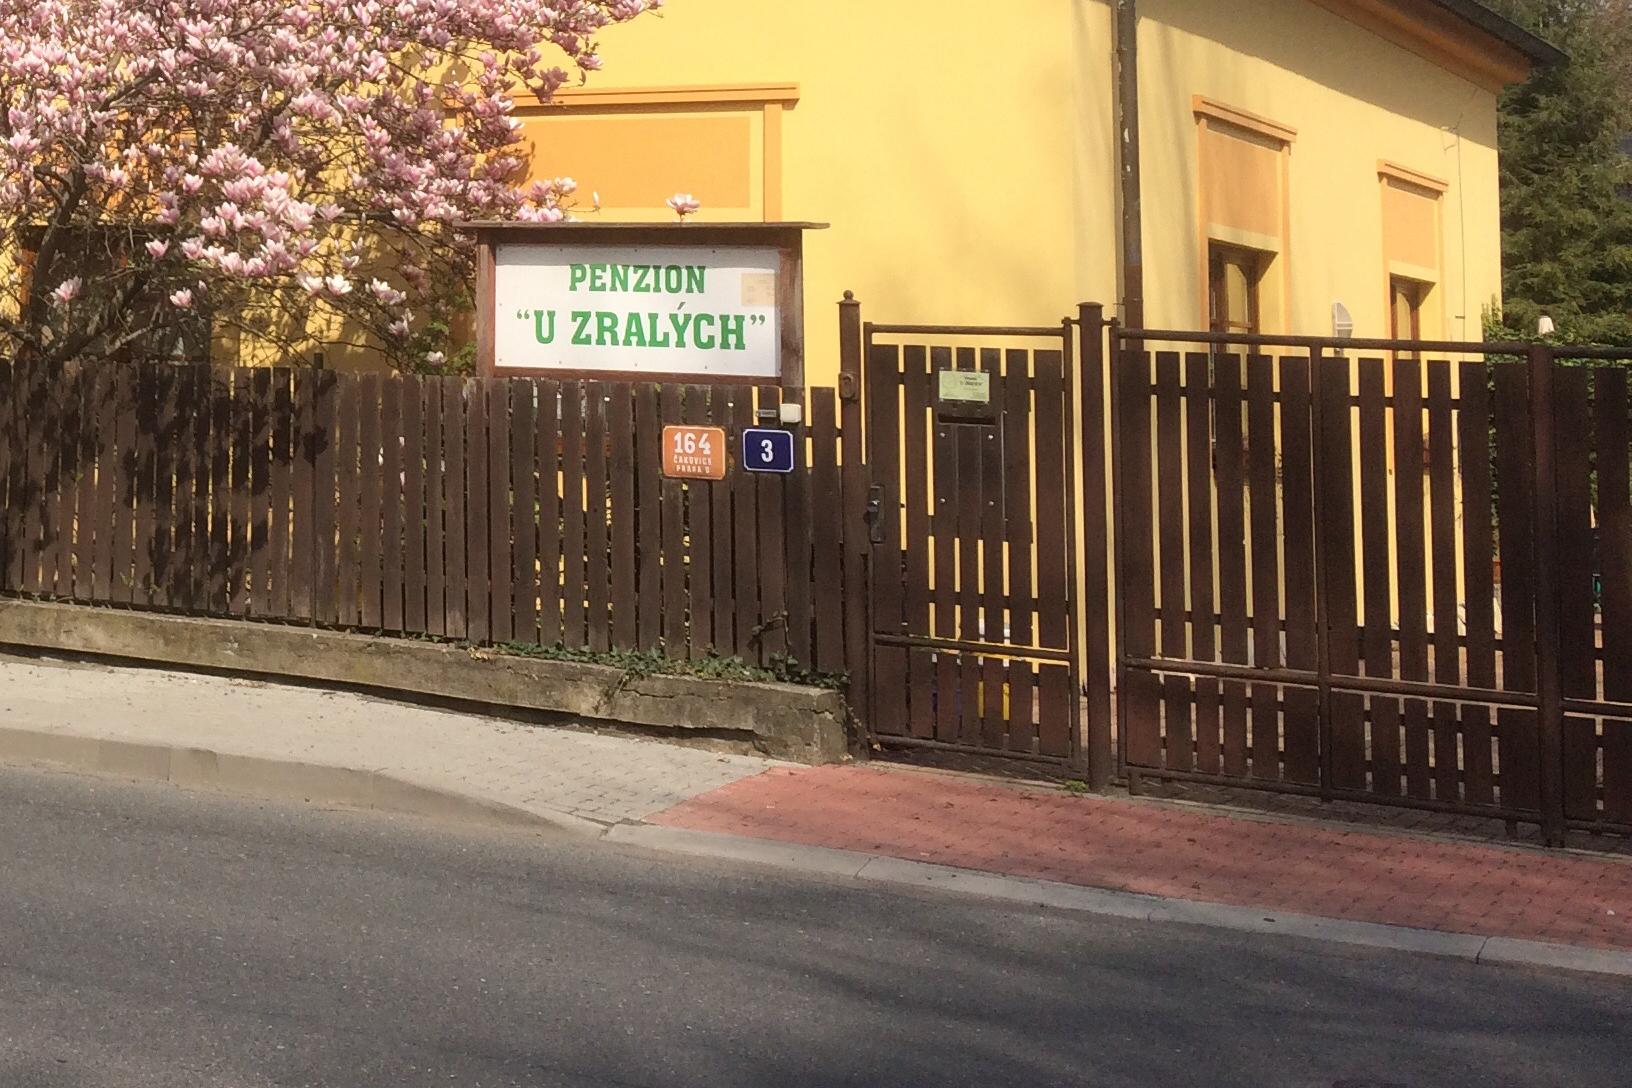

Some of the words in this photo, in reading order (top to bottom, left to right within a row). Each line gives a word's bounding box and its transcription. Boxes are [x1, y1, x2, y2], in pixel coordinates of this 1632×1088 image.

[568, 263, 706, 294] PENZION
[674, 431, 711, 455] 164
[760, 439, 774, 462] 3
